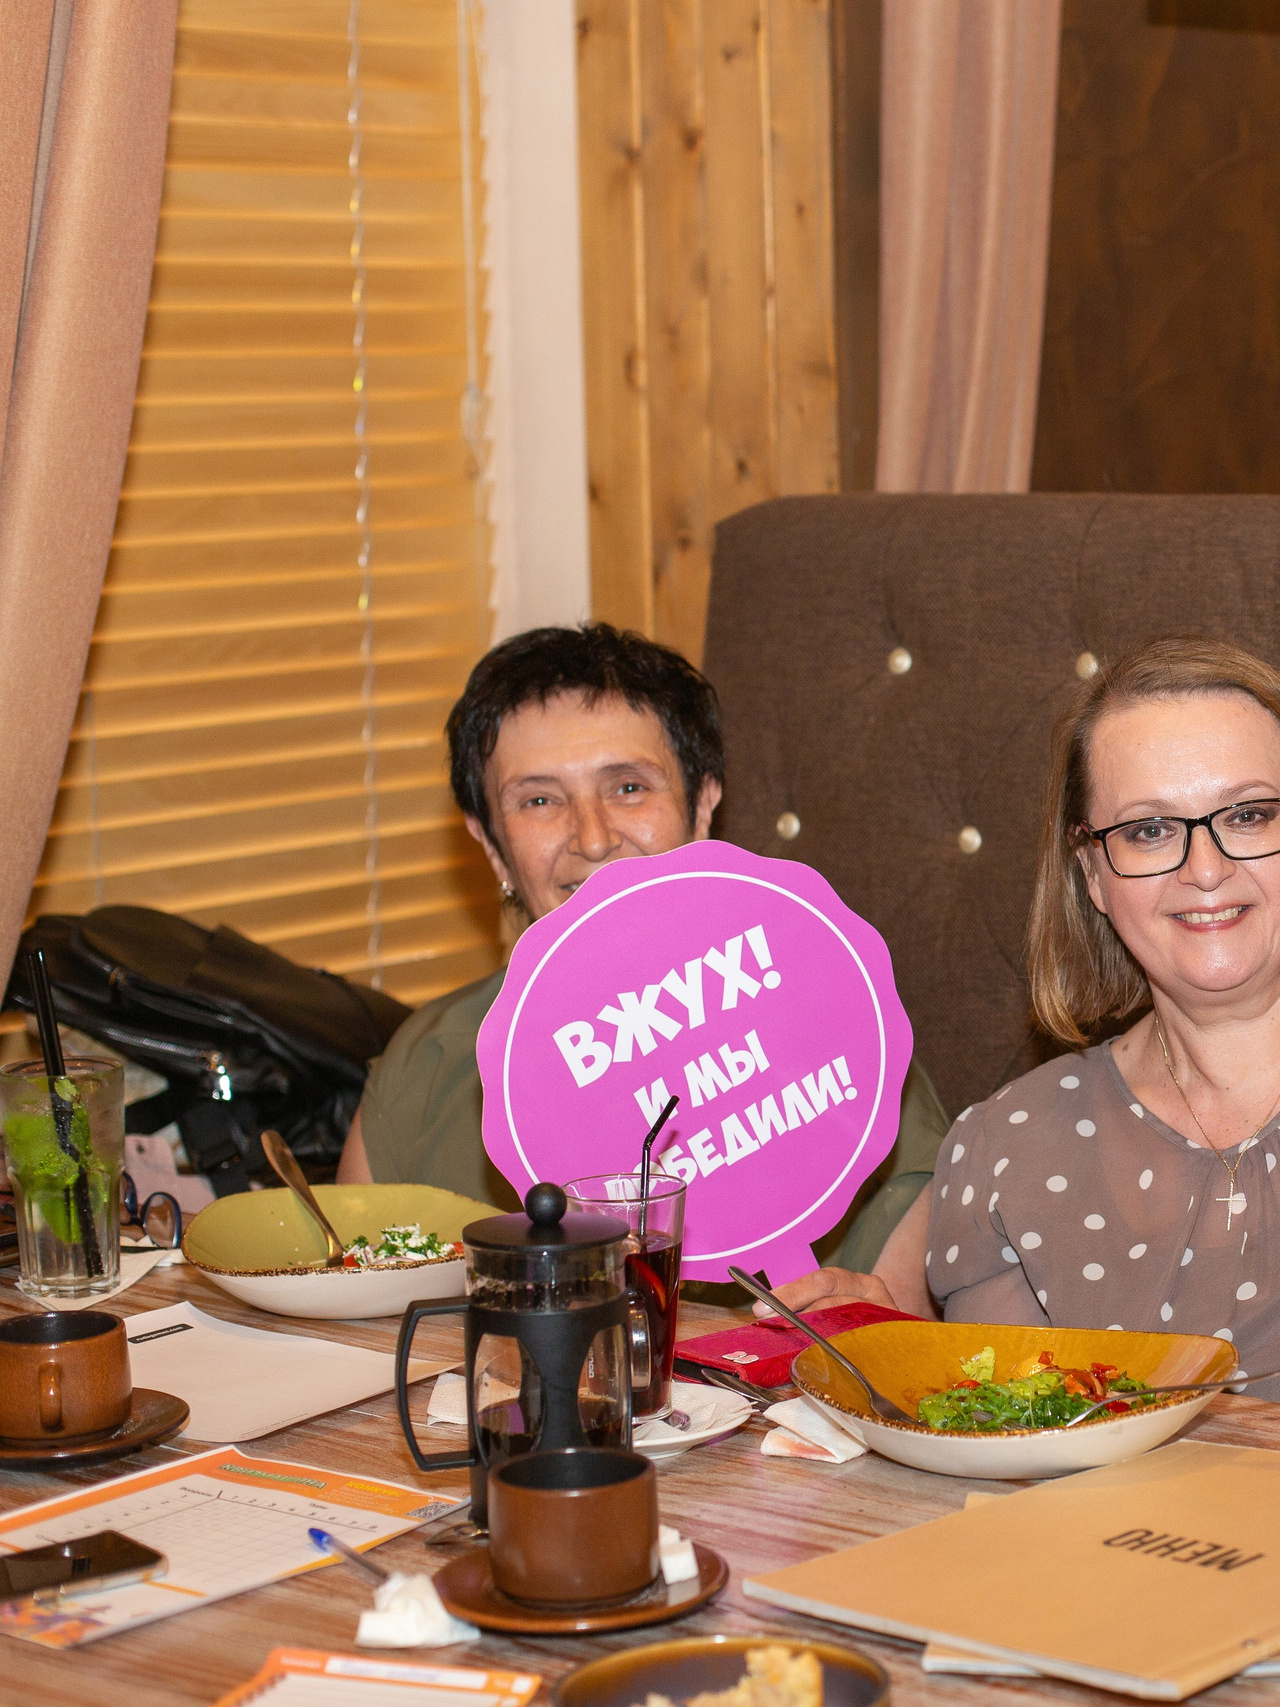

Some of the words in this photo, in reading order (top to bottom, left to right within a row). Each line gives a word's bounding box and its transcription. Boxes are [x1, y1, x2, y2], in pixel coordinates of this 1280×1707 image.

[552, 924, 782, 1089] ВЖУХ!
[633, 1076, 679, 1130] И
[683, 1029, 770, 1108] МЫ
[1102, 1528, 1266, 1573] МЕНЮ
